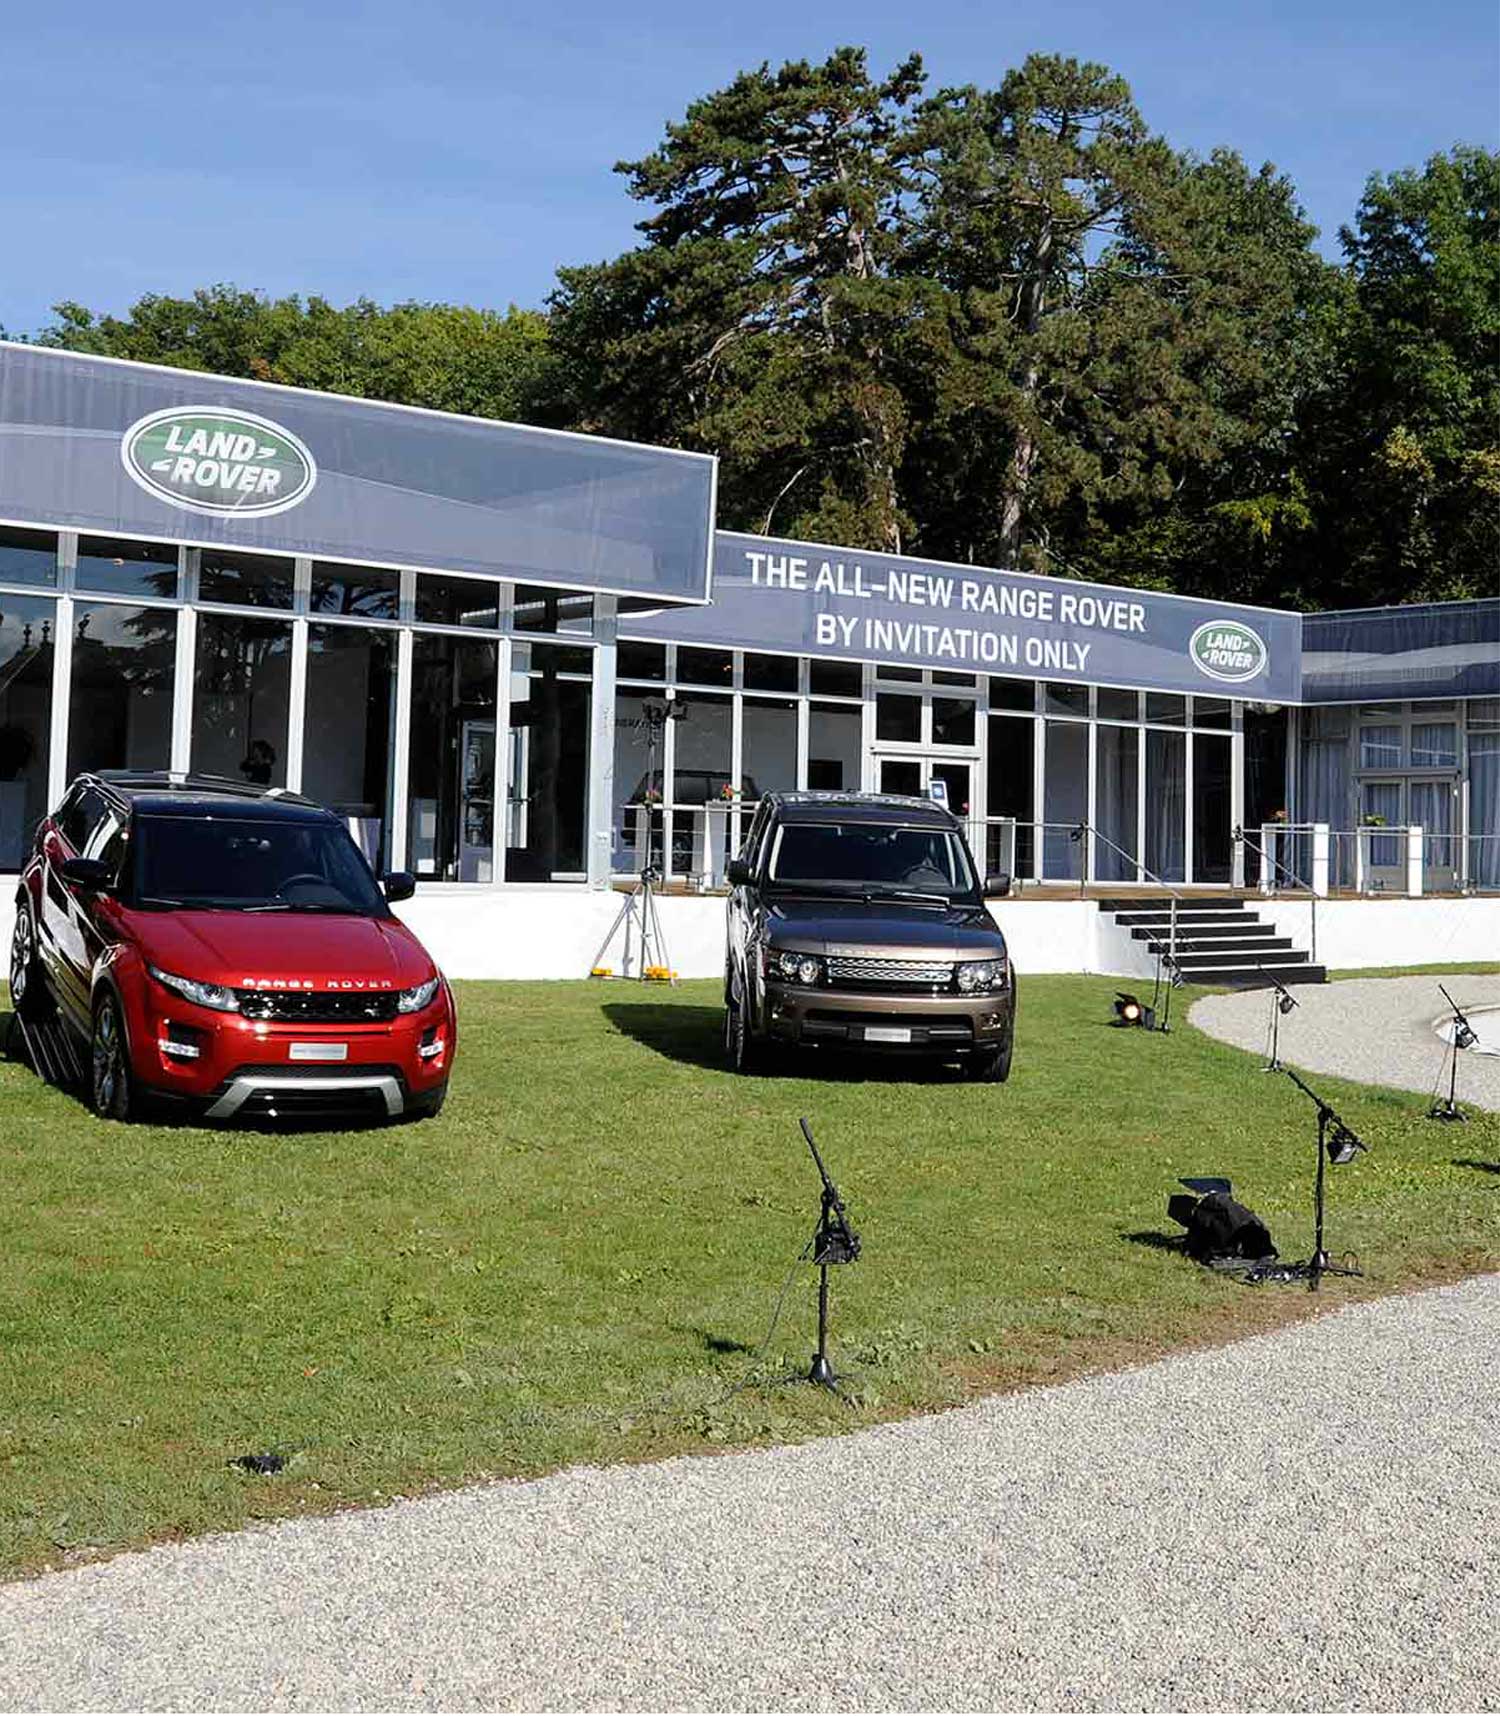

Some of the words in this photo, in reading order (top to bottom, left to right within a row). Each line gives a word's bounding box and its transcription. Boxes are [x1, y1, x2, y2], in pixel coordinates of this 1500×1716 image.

[164, 425, 257, 462] LAND
[170, 456, 282, 496] ROVER
[745, 552, 808, 591] THE
[814, 562, 954, 608] ALL-NEW
[961, 580, 1054, 621] RANGE
[1060, 594, 1146, 633] ROVER
[816, 613, 858, 647] BY
[865, 618, 1018, 665] INVITATION
[1025, 637, 1090, 671] ONLY
[1205, 632, 1243, 650] LAND
[1208, 649, 1253, 668] ROVER
[242, 977, 314, 989] RANGE
[327, 979, 392, 989] ROVER
